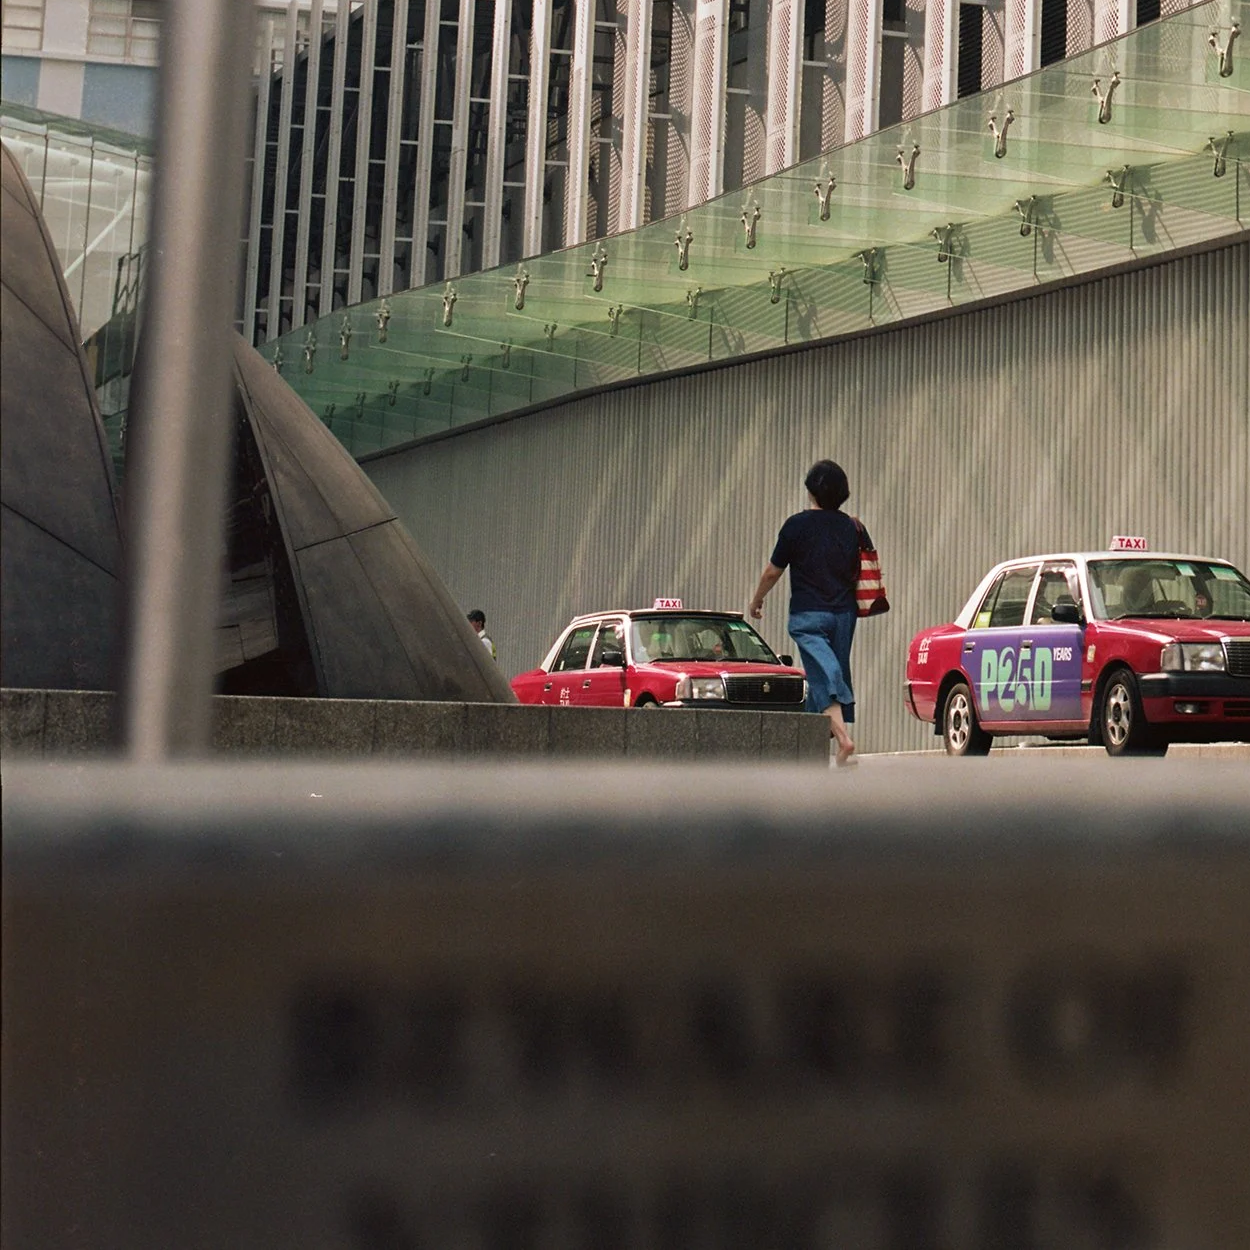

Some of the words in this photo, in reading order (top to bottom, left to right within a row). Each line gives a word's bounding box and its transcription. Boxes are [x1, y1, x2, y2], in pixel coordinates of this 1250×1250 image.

[1118, 538, 1146, 549] TAXI
[659, 600, 681, 608] TAXI
[1052, 646, 1073, 662] YEARS
